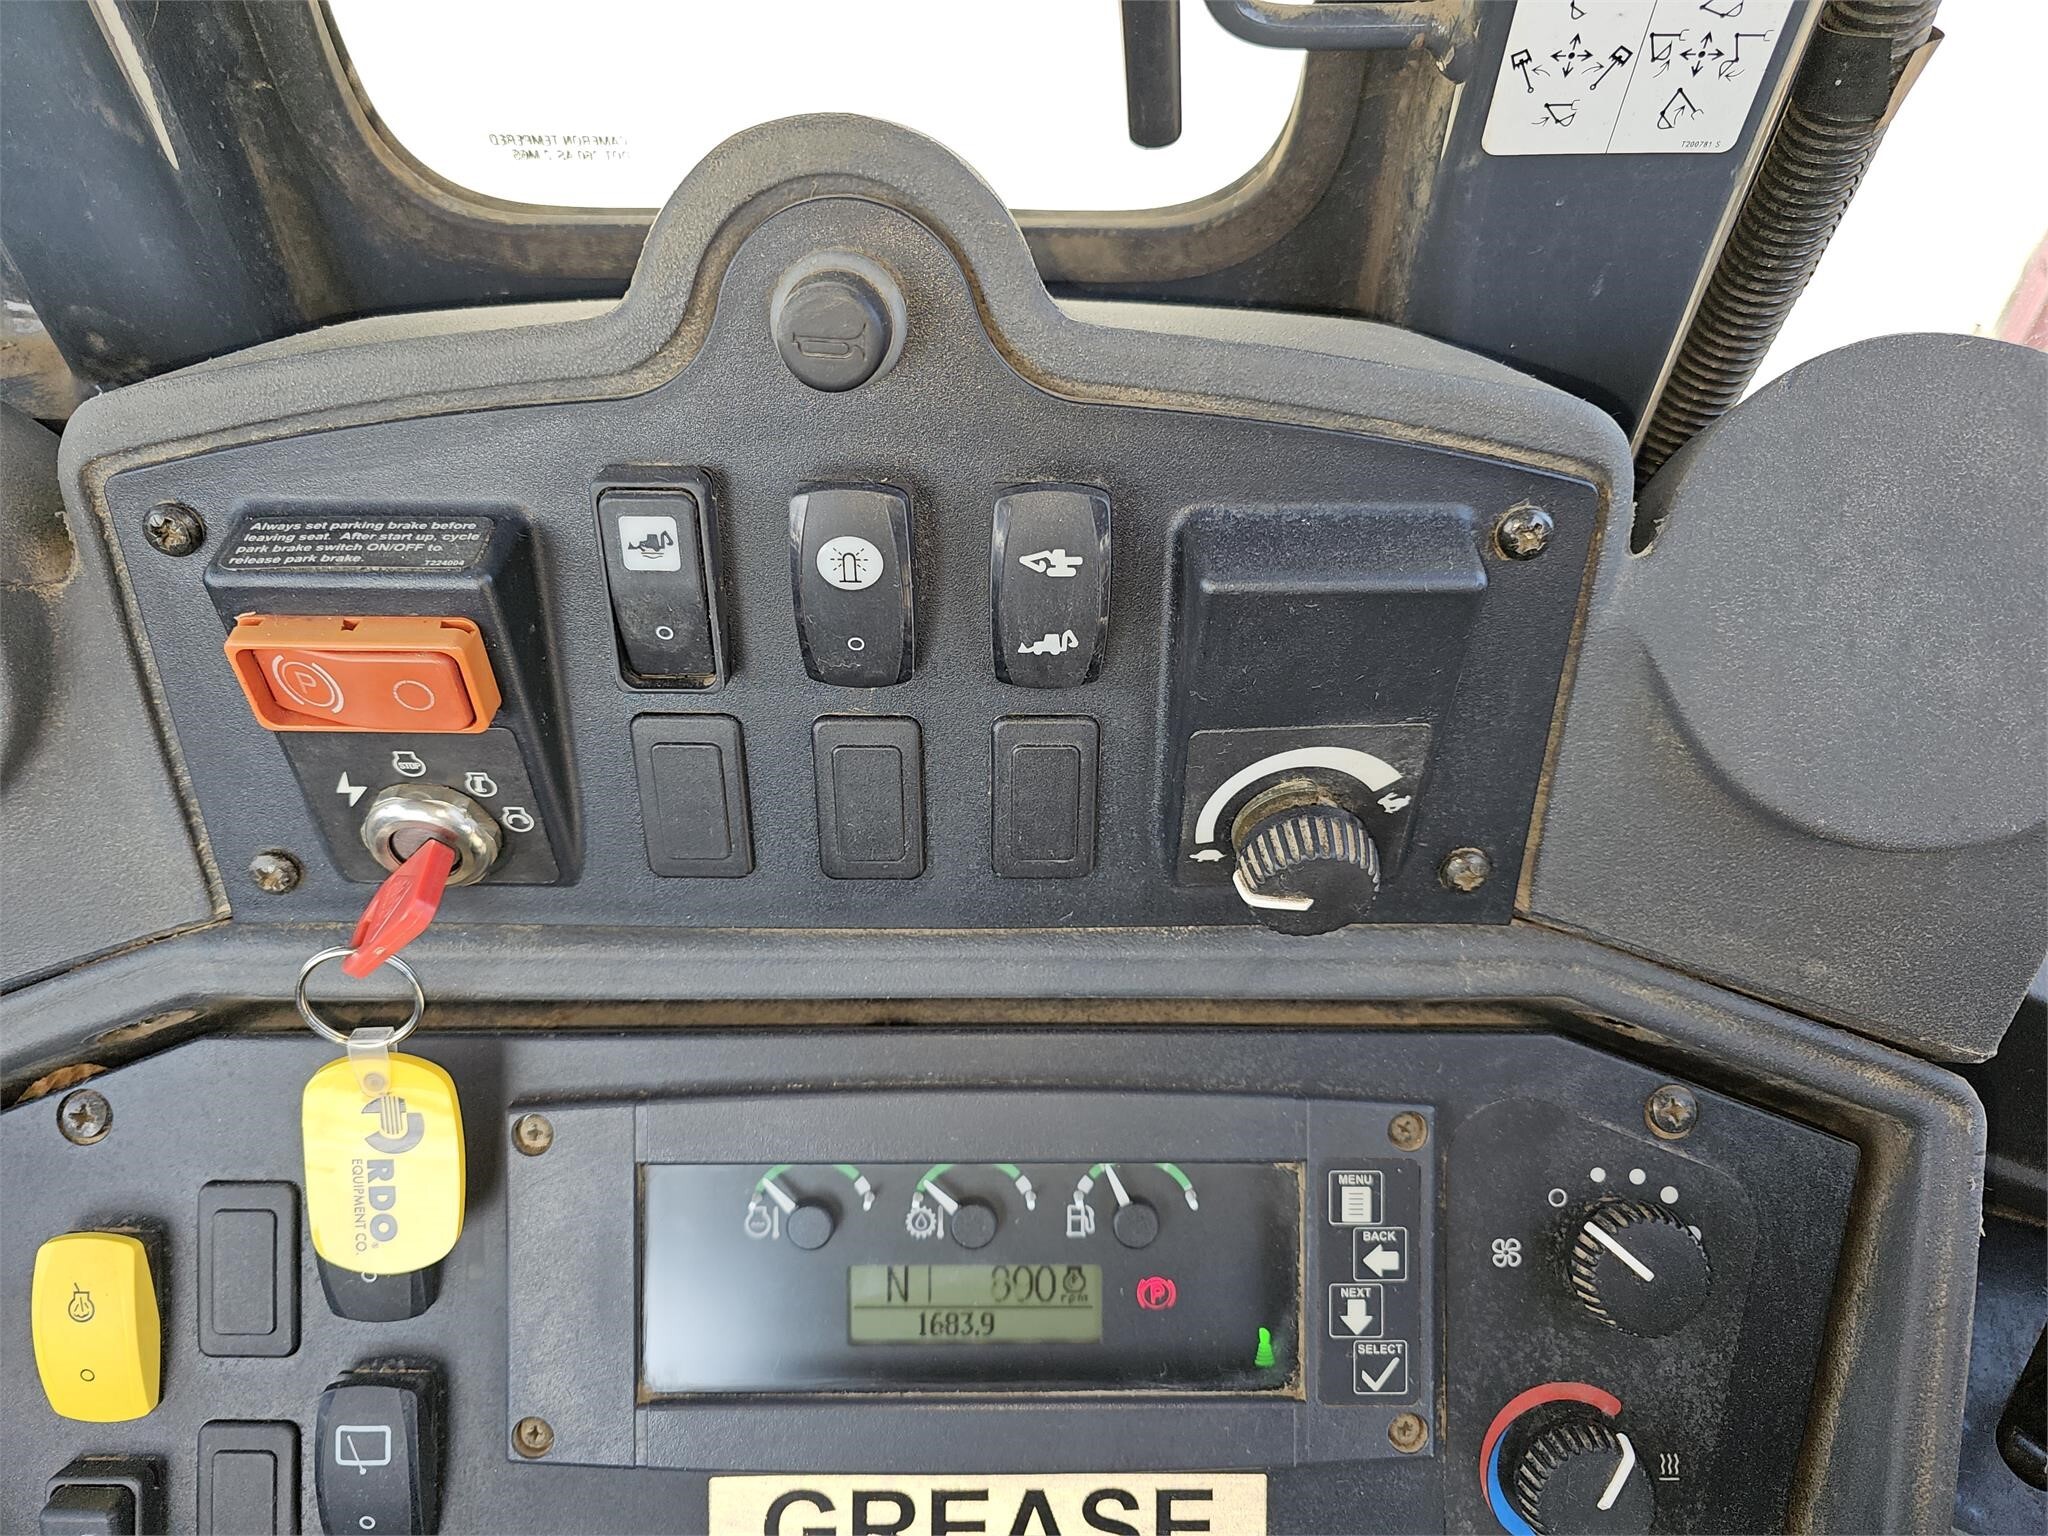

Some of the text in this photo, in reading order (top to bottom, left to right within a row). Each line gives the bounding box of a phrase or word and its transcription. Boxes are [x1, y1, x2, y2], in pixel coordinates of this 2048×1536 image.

[250, 521, 477, 532] Always set parking brake before
[243, 531, 482, 544] leaving seat. After start up, cycle
[235, 543, 443, 555] park brake switch ON/OFF to
[228, 554, 365, 565] release park brake.
[398, 761, 421, 770] STOP
[1338, 1174, 1373, 1186] MENU
[366, 1159, 399, 1242] RDO
[351, 1158, 368, 1256] EQUIPMENT CO.
[1362, 1230, 1397, 1242] BACK
[886, 1265, 909, 1303] N
[1060, 1293, 1089, 1304] rpm
[1340, 1287, 1372, 1298] NEXT
[918, 1311, 996, 1337] 1683.9
[1356, 1344, 1404, 1355] SELECT
